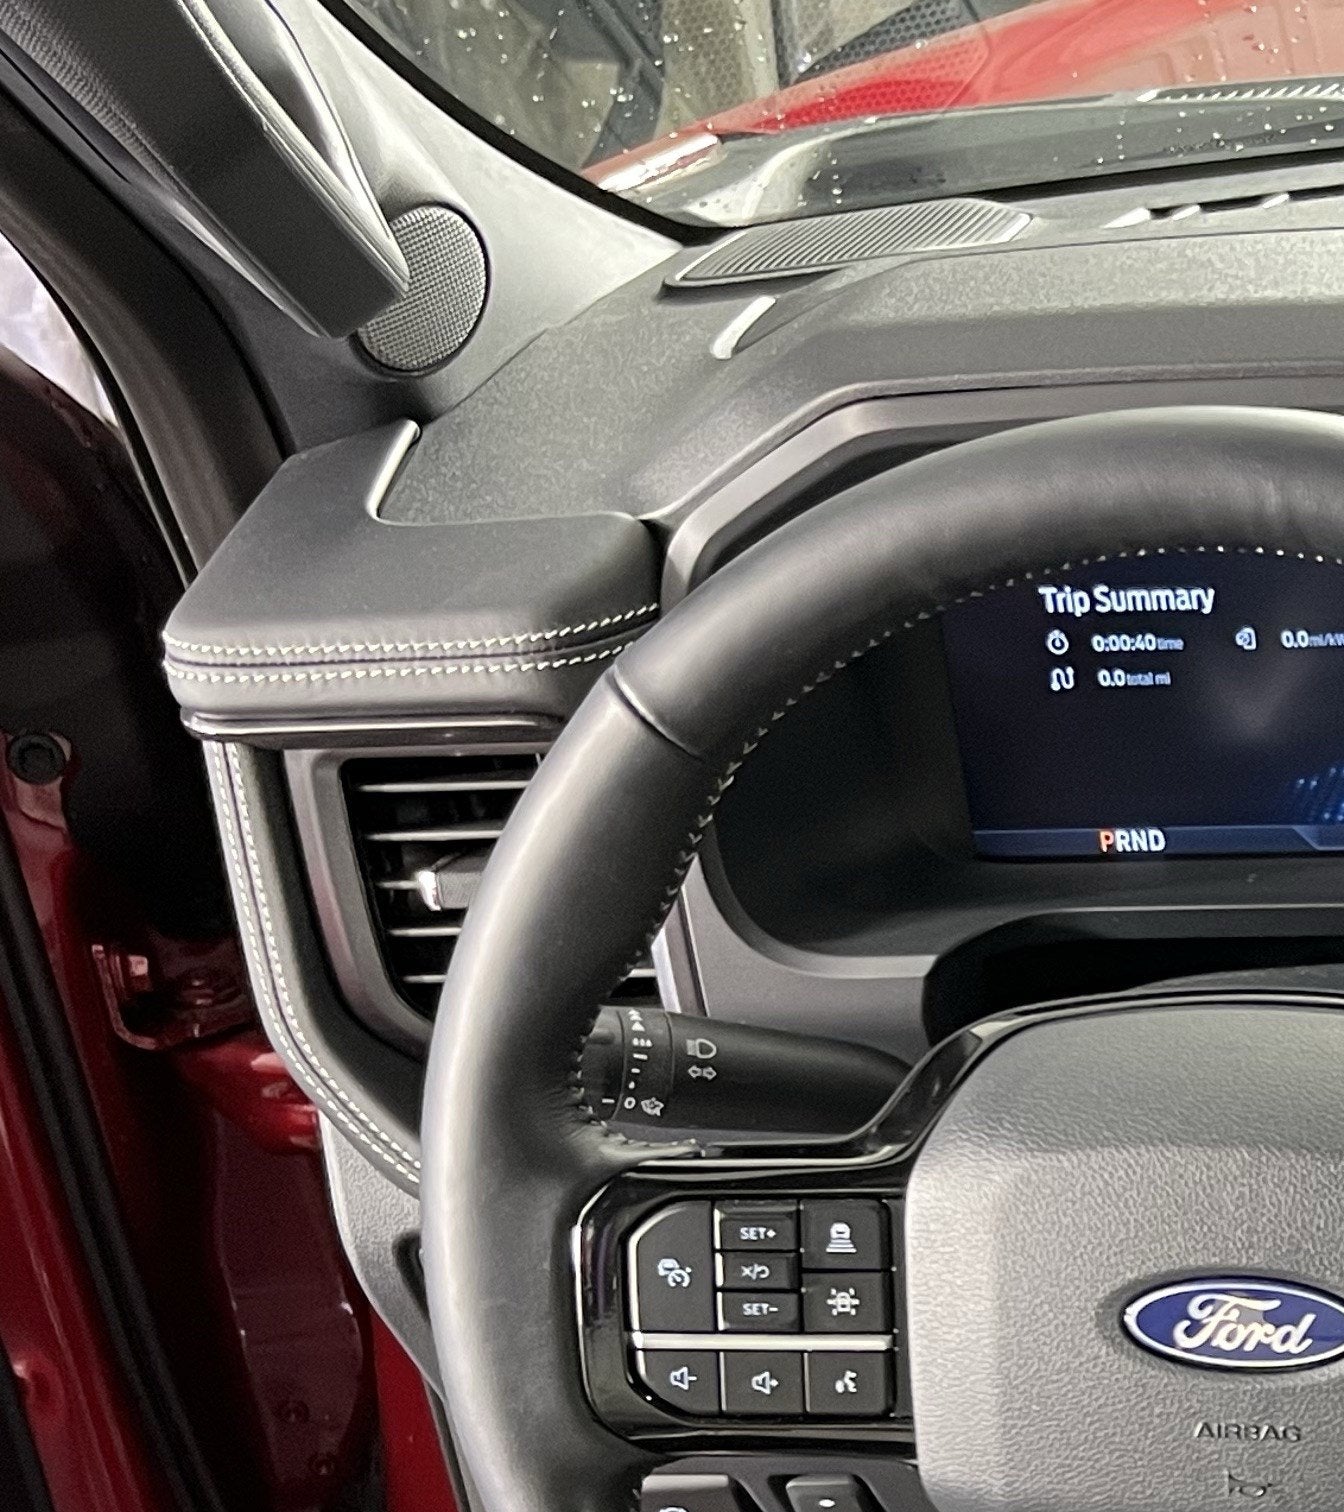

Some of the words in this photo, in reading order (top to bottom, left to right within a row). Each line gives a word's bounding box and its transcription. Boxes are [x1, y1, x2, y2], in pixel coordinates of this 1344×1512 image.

[1038, 586, 1091, 617] Trip
[1094, 585, 1215, 615] Summary
[1091, 634, 1157, 652] 0:00:40
[1280, 629, 1309, 648] 0.0
[1097, 668, 1126, 687] 0.0
[1126, 672, 1154, 686] total
[1099, 828, 1166, 852] PRND
[740, 1227, 776, 1240] SET+
[743, 1303, 779, 1315] SET-
[1172, 1292, 1317, 1354] Ford
[1193, 1422, 1302, 1443] AIRBAG
